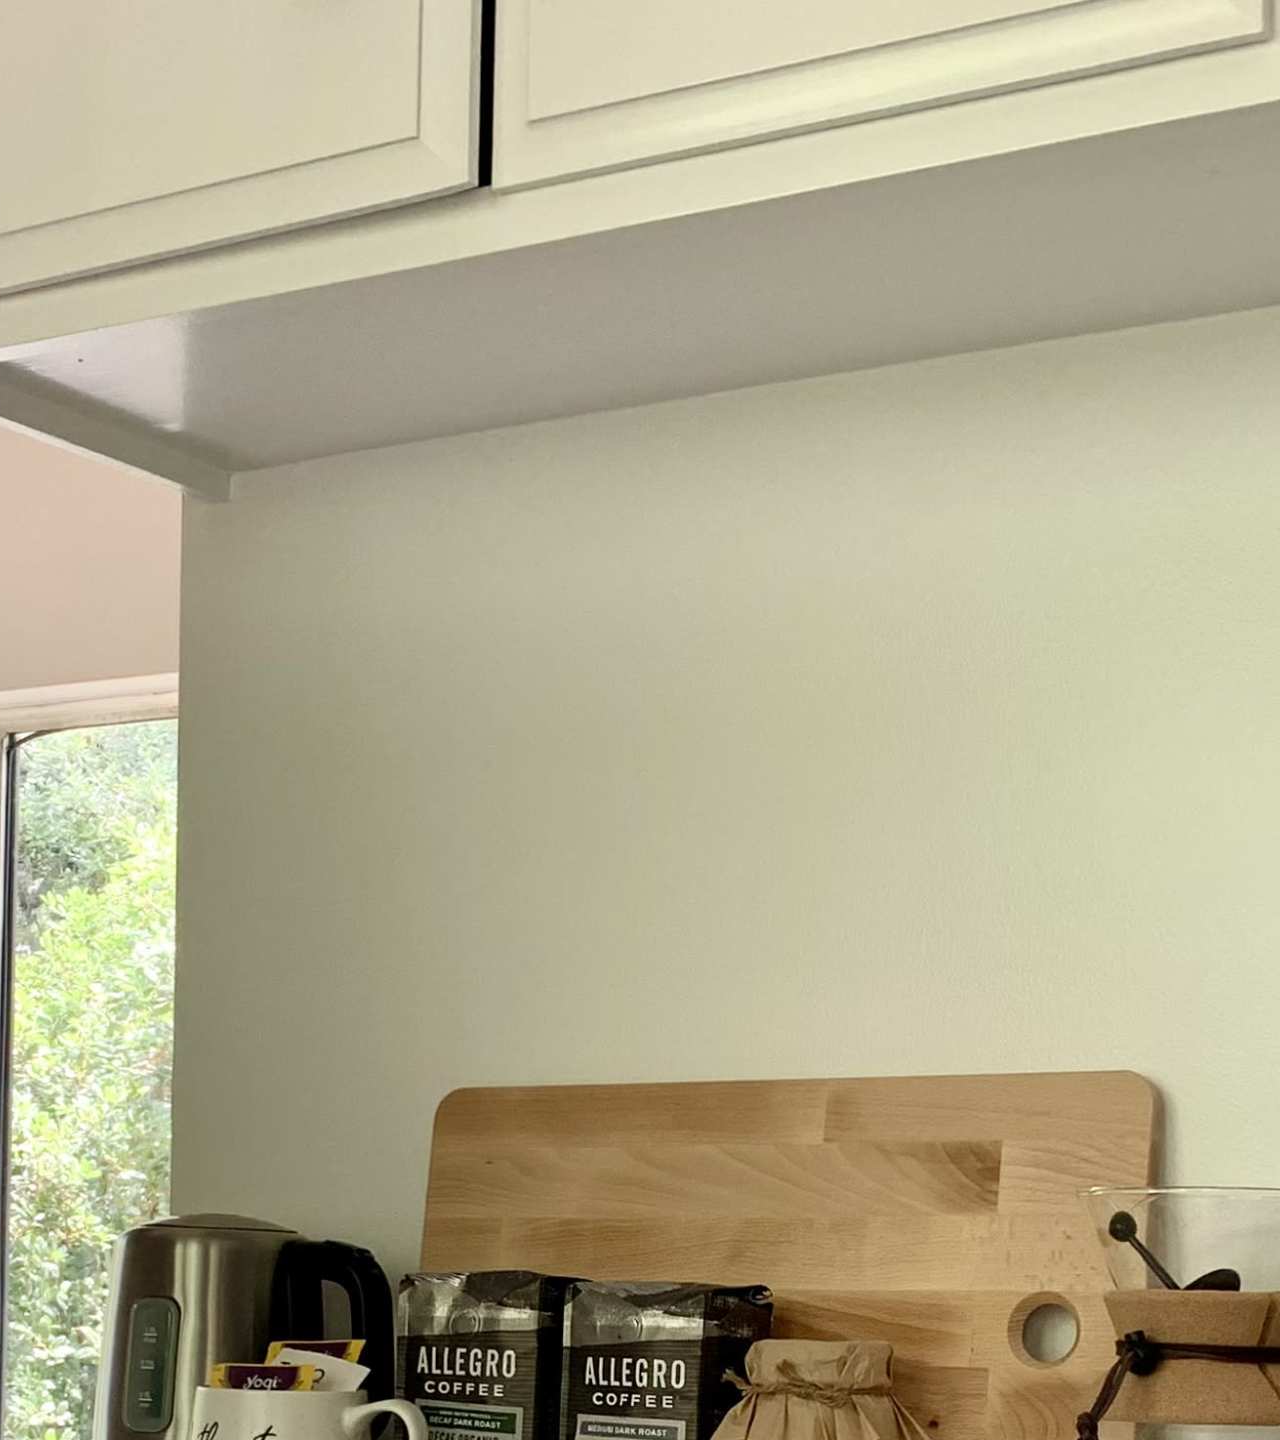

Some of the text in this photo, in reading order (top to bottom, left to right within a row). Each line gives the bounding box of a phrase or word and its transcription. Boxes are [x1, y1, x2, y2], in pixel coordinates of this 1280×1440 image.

[417, 1346, 516, 1378] ALLEGRO
[585, 1356, 686, 1389] ALLEGRO
[424, 1381, 505, 1397] COFFEE
[592, 1392, 674, 1408] COFFEE
[453, 1418, 473, 1426] DARK
[474, 1420, 501, 1429] ROAST
[615, 1426, 637, 1435] DARK
[638, 1428, 668, 1437] ROAST
